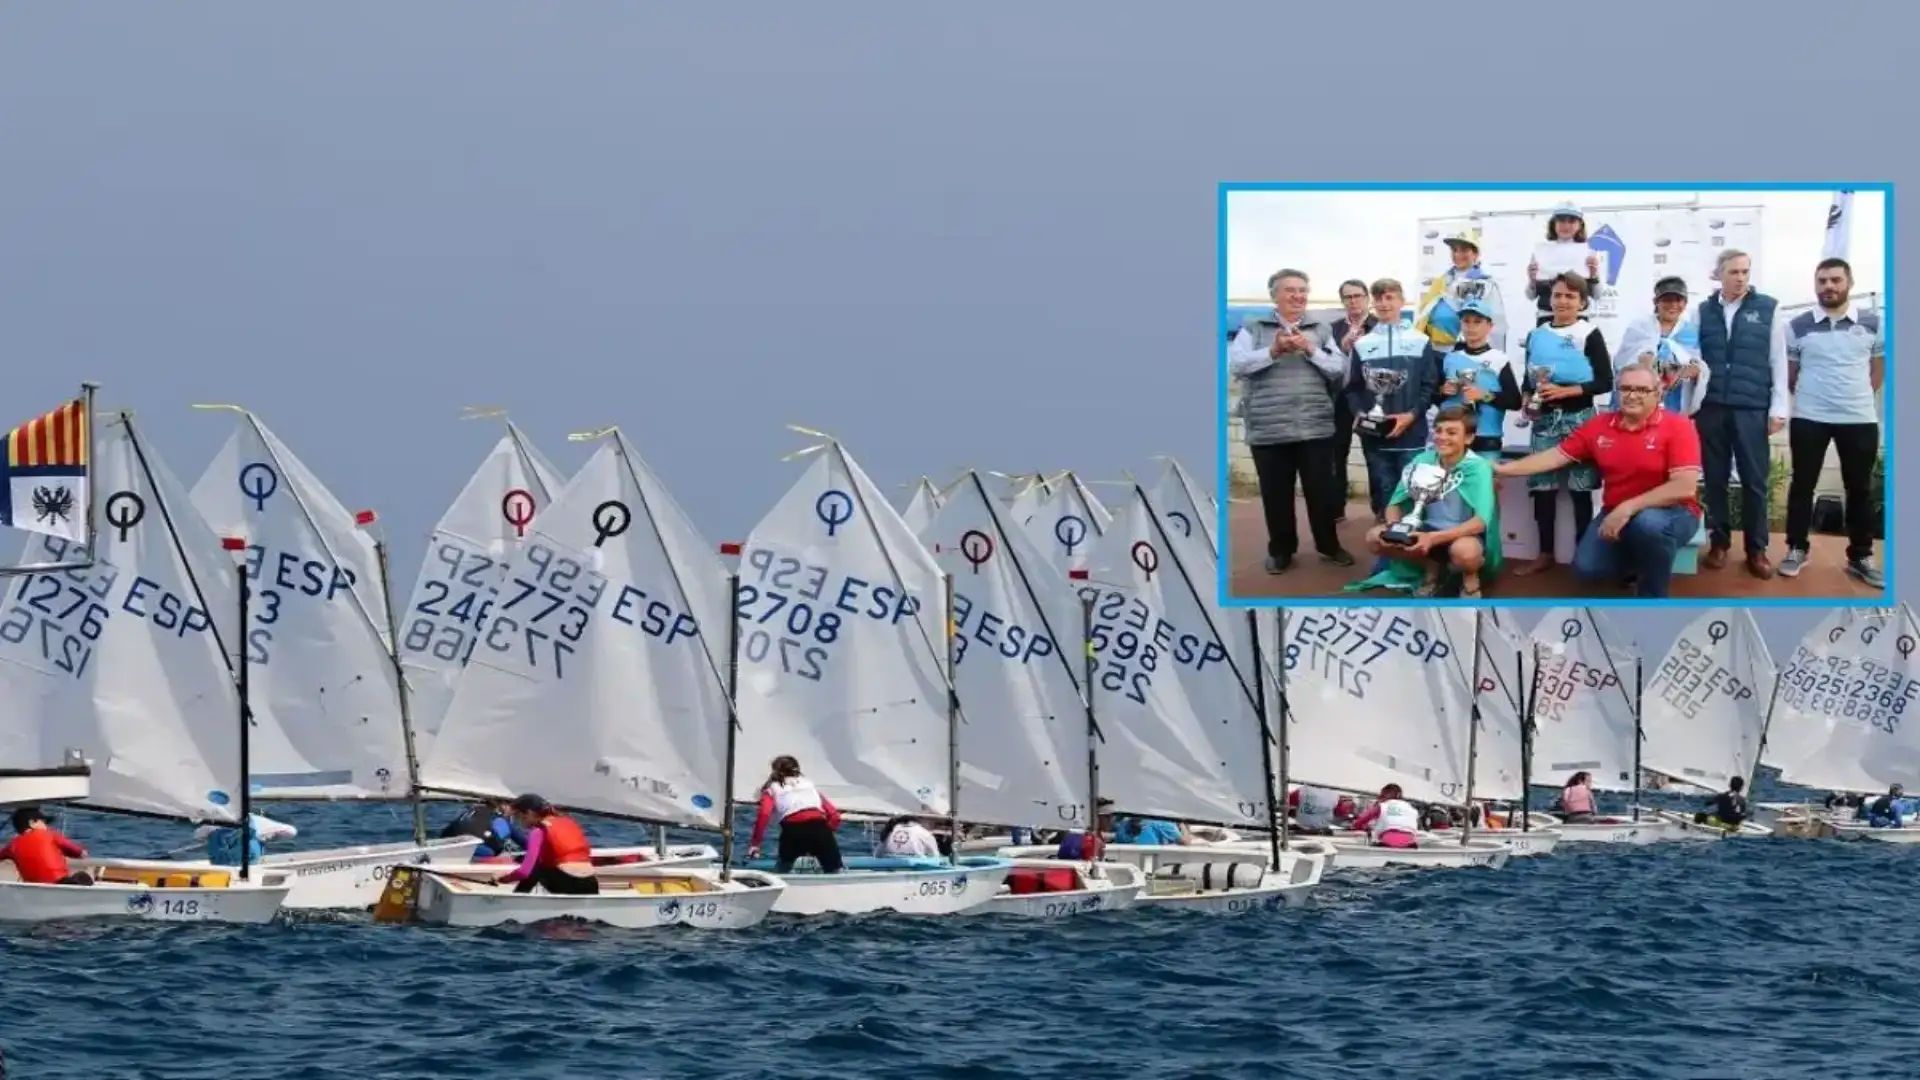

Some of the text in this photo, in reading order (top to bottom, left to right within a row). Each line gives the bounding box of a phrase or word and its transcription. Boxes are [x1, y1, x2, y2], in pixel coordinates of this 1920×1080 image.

[277, 552, 357, 601] ESP
[836, 576, 922, 625] ESP
[17, 574, 110, 642] 1276
[122, 576, 210, 638] ESP
[502, 577, 590, 642] 773
[611, 584, 701, 645] ESP
[737, 585, 843, 644] 2708
[975, 610, 1053, 664] ESP
[1153, 617, 1228, 672] ESP
[1383, 616, 1450, 663] ESP
[1568, 661, 1619, 690] ESP
[1709, 667, 1753, 700] ESP
[1848, 679, 1907, 715] 2368
[162, 899, 200, 916] 148
[685, 902, 718, 919] 149
[919, 880, 947, 897] 065
